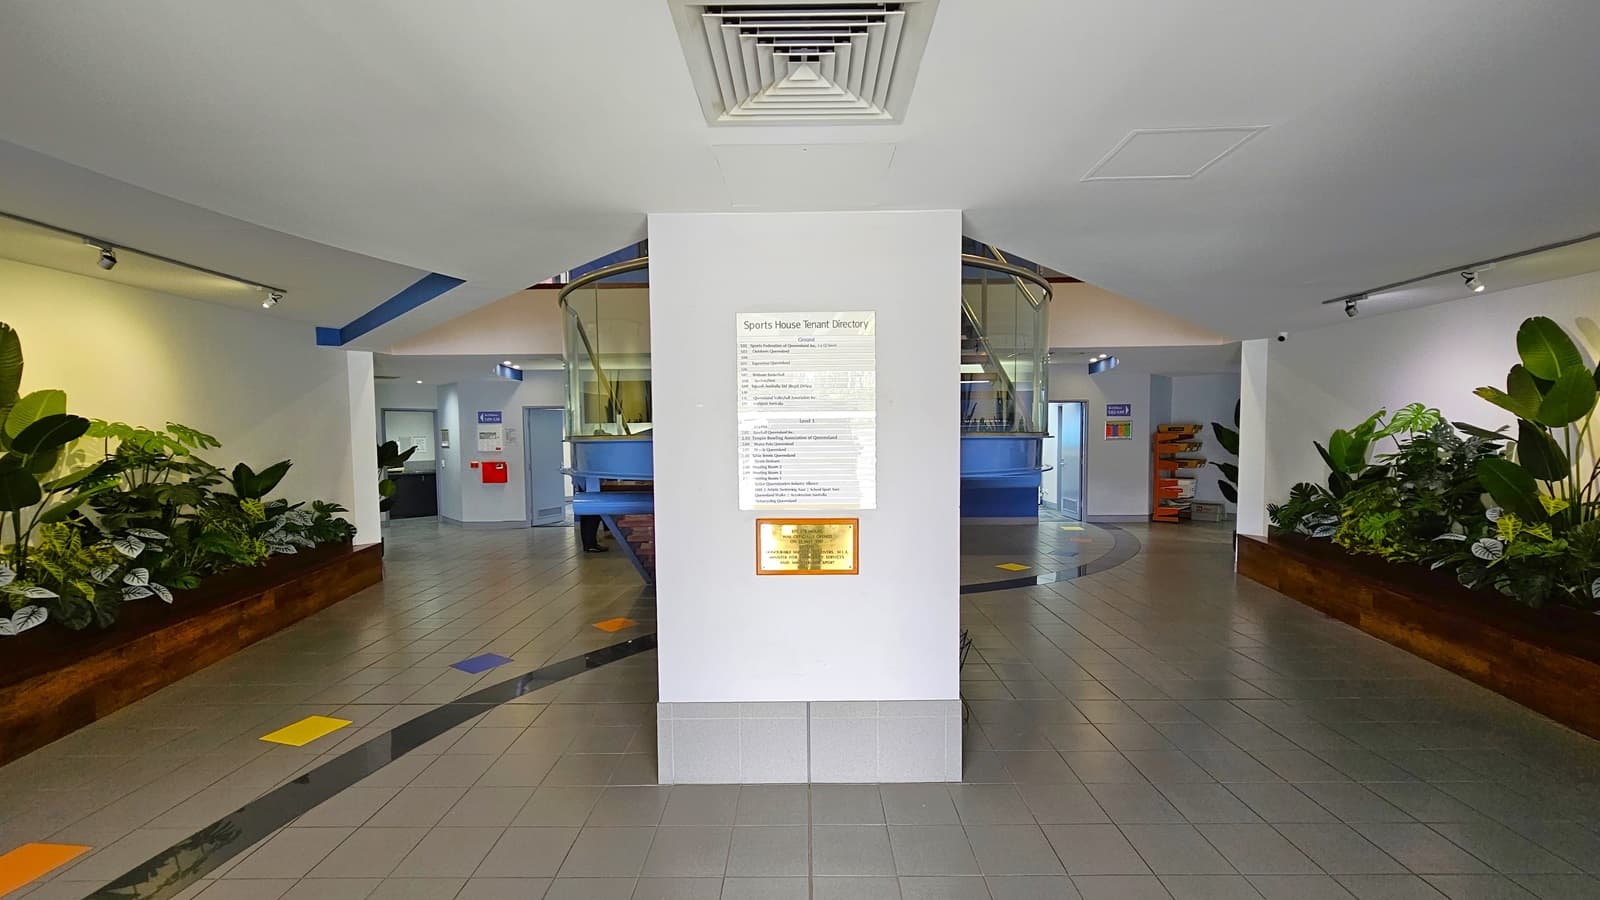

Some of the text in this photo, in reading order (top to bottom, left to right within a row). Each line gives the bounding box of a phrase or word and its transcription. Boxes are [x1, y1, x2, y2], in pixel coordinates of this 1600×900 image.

[744, 320, 868, 331] Sports House Tenant Directory
